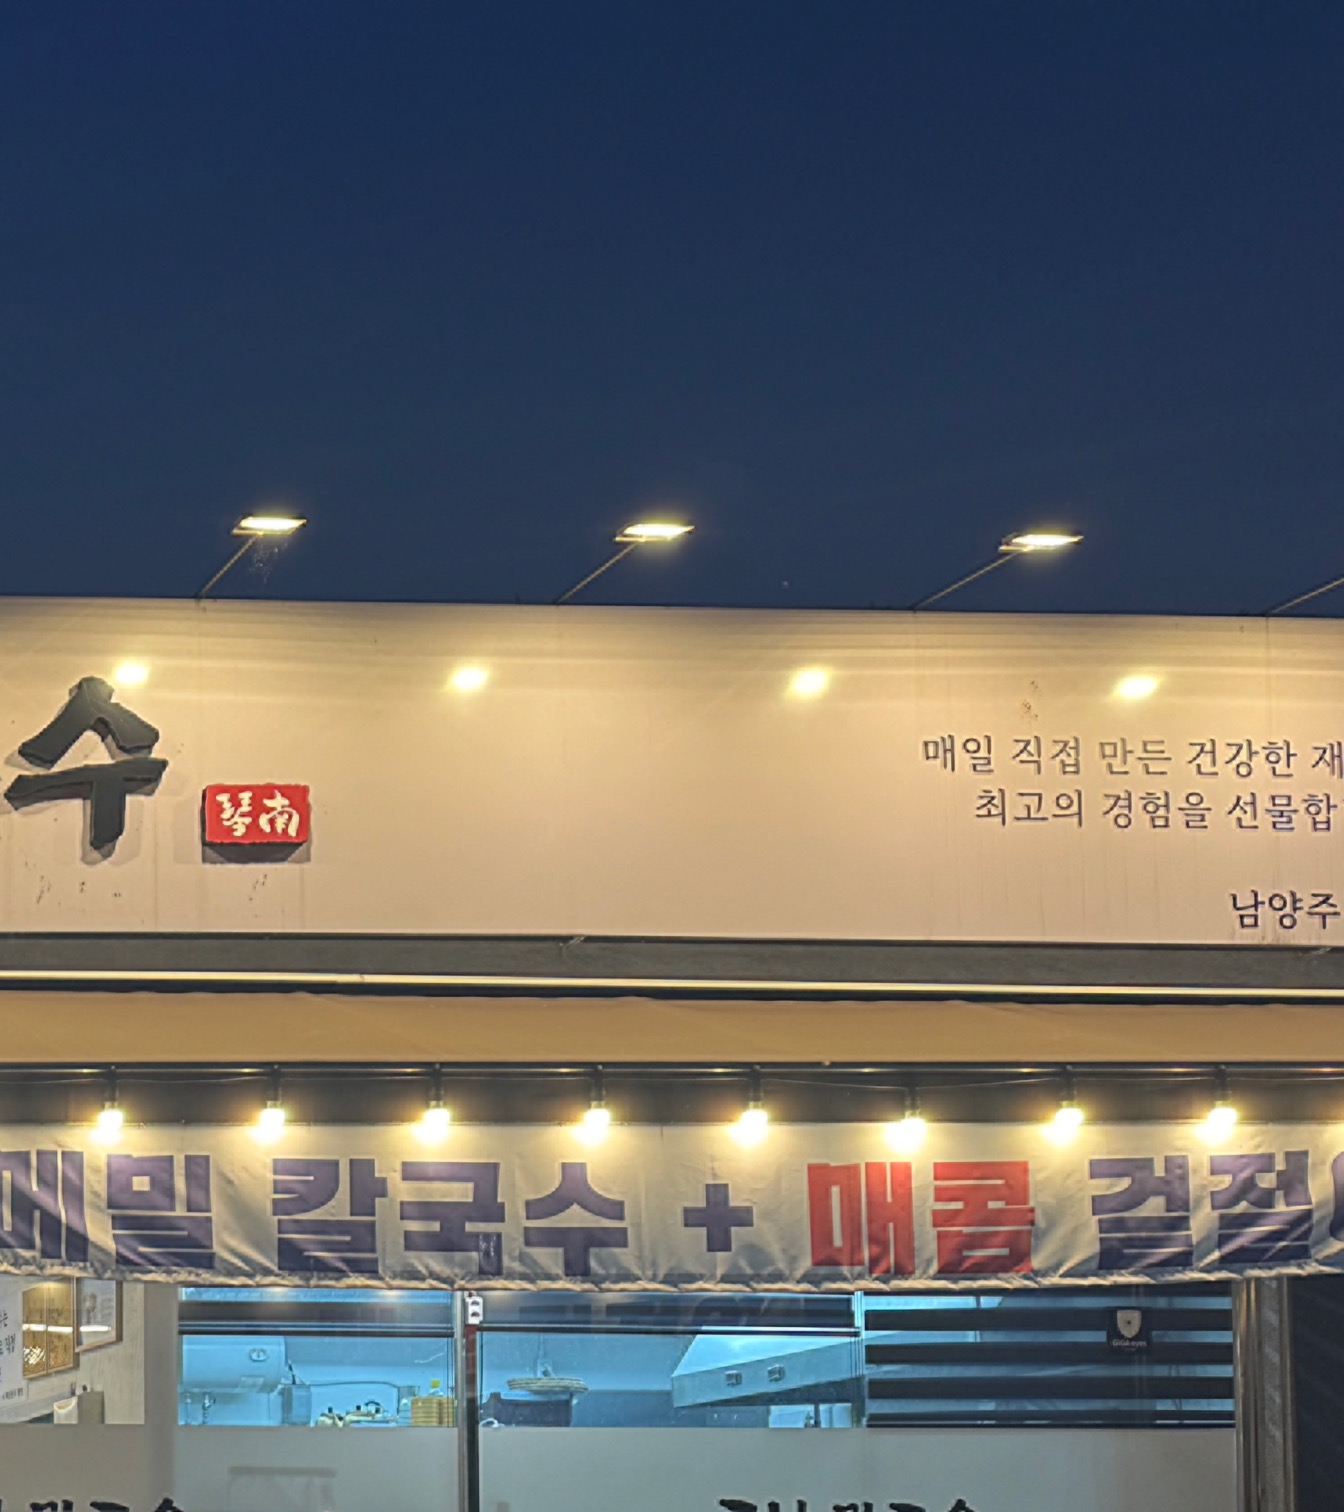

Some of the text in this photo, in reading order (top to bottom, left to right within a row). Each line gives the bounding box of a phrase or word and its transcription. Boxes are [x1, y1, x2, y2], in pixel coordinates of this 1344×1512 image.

[921, 733, 1344, 780] 매일 직접 만든 건강한 재
[975, 788, 1344, 833] 최고의 경험을 선물합
[1229, 889, 1342, 931] 남양주
[271, 1157, 629, 1277] 칼국수
[807, 1159, 1037, 1277] 매콤
